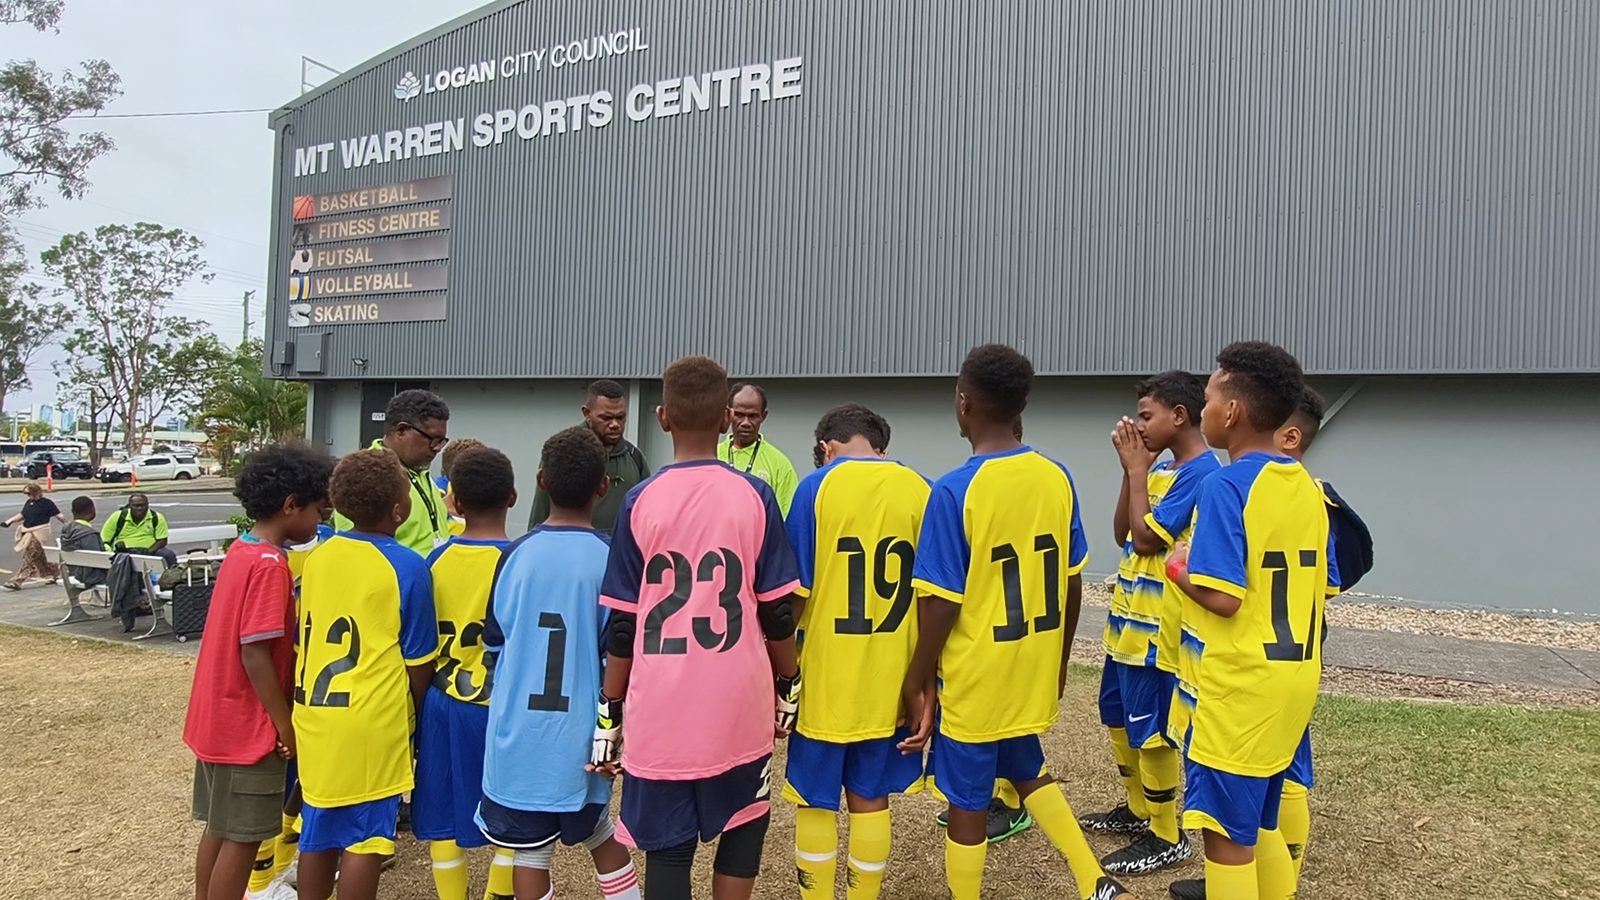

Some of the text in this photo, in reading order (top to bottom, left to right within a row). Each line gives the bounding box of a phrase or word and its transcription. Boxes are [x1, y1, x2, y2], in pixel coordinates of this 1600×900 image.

[424, 27, 649, 95] LOGAN CITY COUNCIL
[294, 57, 803, 178] MT WARREN SPORTS CENTRE
[319, 209, 441, 240] FITNESS CENTRE
[320, 184, 419, 213] BASKETBALL
[316, 271, 413, 295] VOLLEYBALL
[317, 247, 374, 268] FUTSAL
[314, 303, 379, 323] SKATING
[642, 546, 743, 655] 23
[834, 536, 915, 635] 19
[991, 533, 1061, 642] 11
[293, 611, 361, 708] 12
[528, 612, 570, 712] 1
